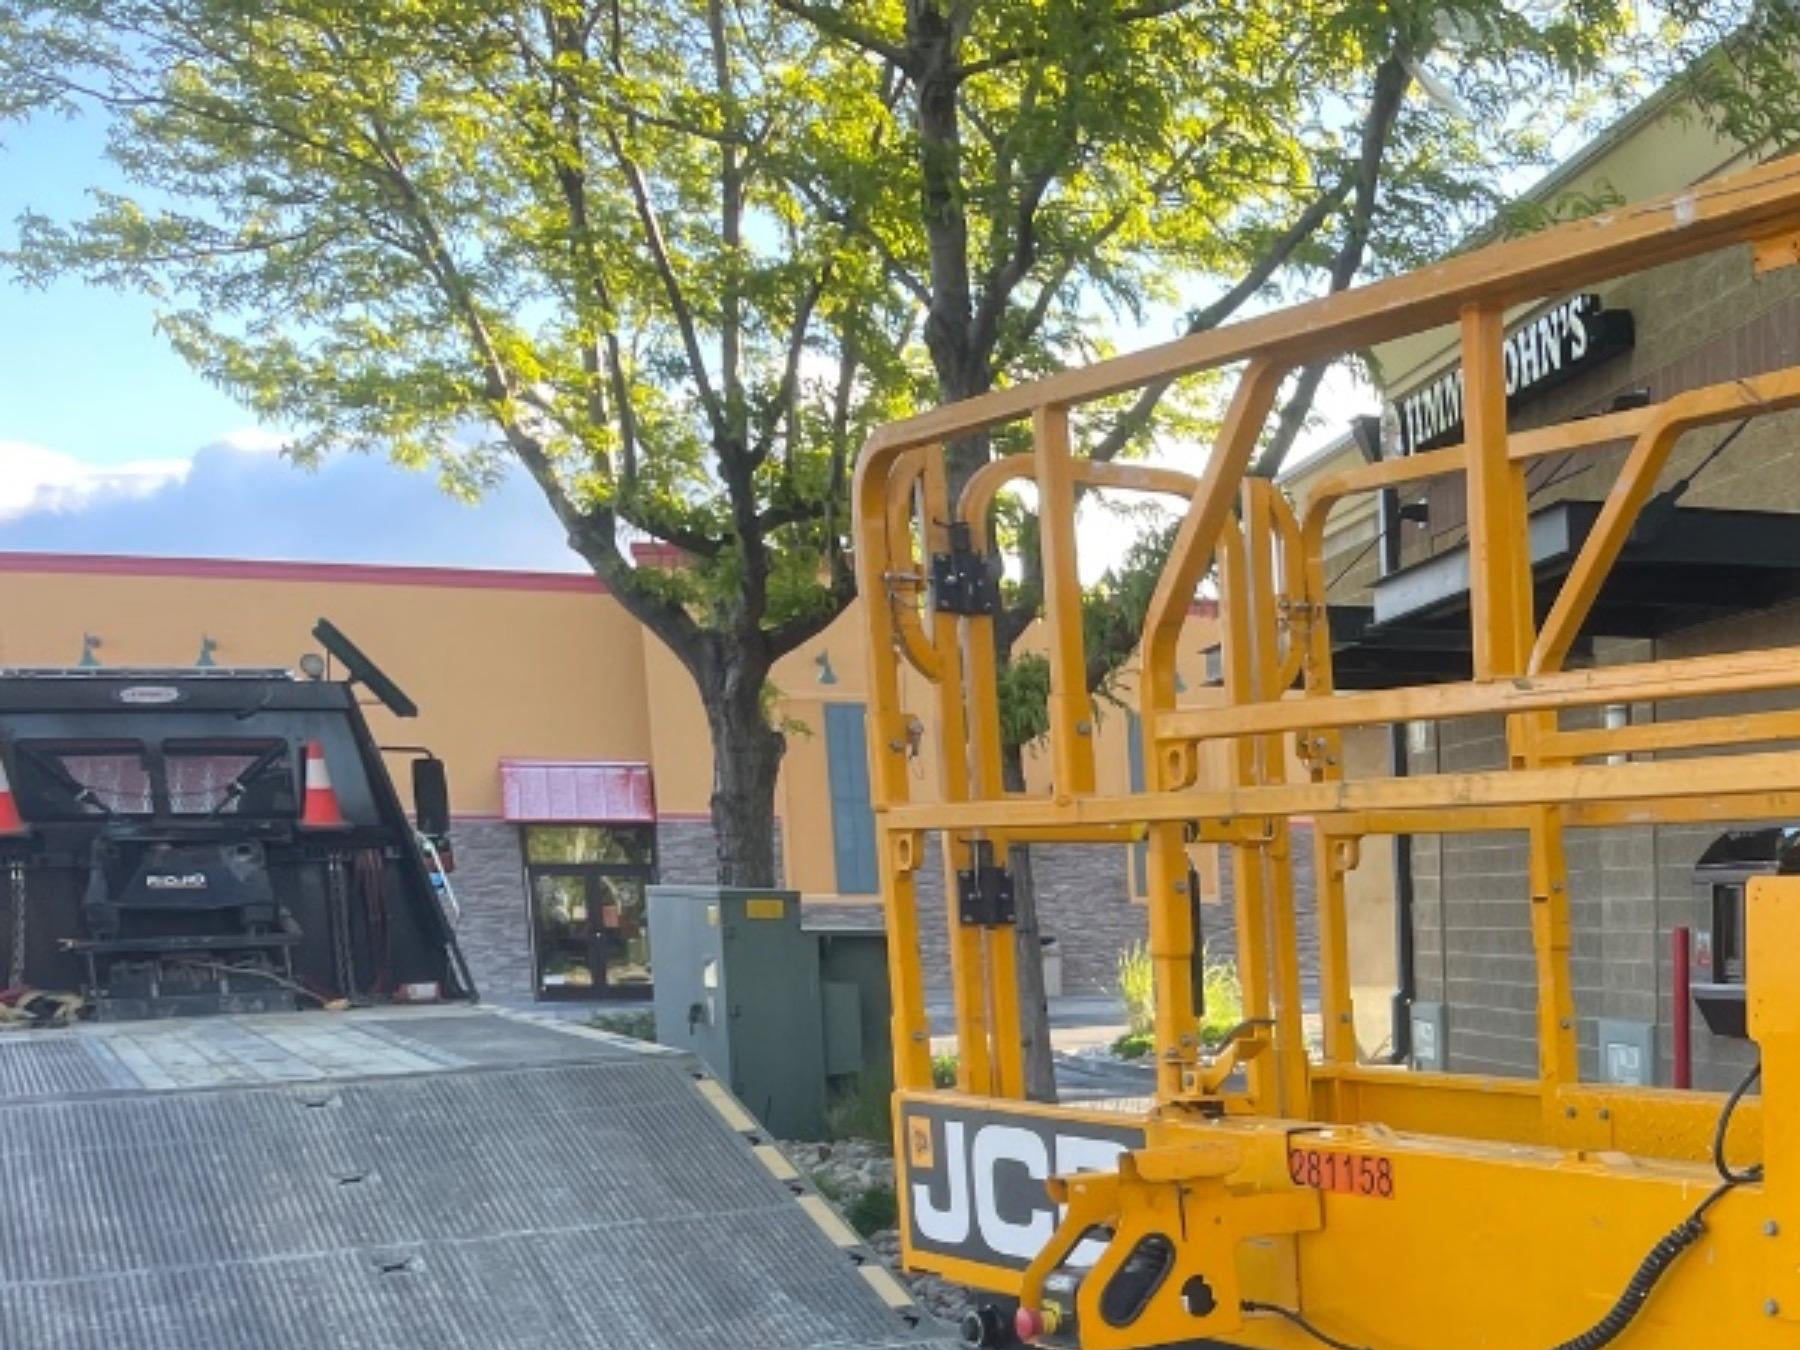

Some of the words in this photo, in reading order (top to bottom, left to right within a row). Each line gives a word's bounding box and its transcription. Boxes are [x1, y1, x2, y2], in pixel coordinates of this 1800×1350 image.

[1403, 368, 1464, 457] JIMM
[1502, 295, 1588, 397] OHN'S
[1289, 1148, 1393, 1198] 281158
